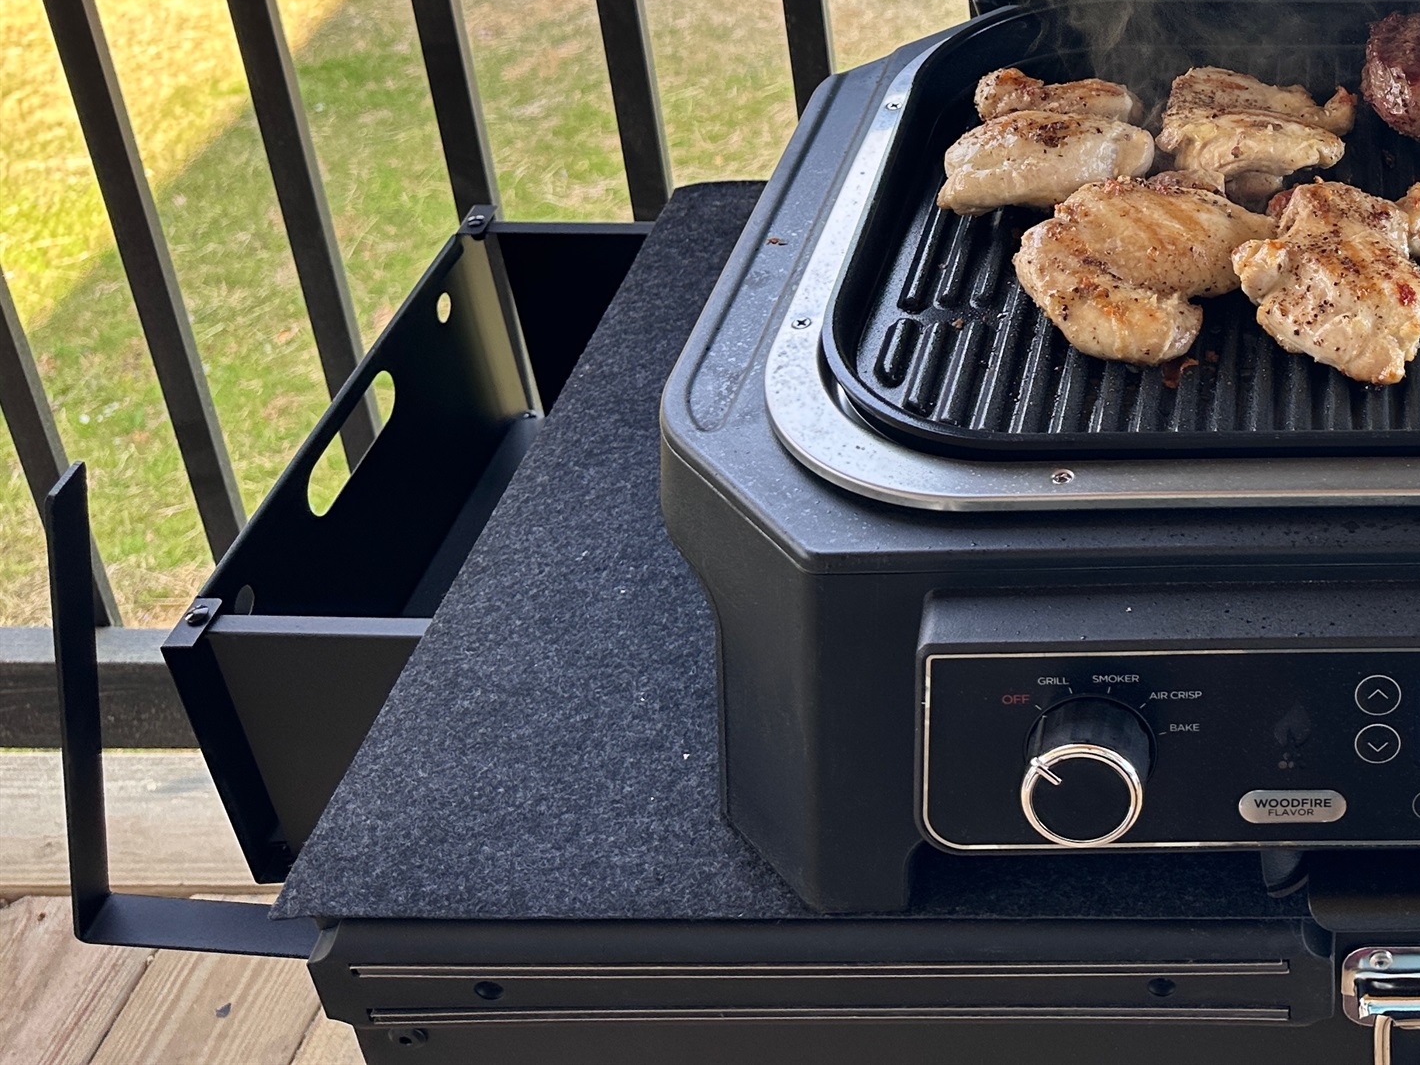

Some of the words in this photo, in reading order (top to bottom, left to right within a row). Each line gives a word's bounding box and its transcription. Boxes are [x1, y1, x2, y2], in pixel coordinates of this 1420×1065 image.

[1037, 676, 1069, 685] GRILL
[1092, 674, 1140, 683] SMOKER
[1002, 694, 1030, 705] OFF
[1149, 691, 1168, 700] AIR
[1170, 690, 1202, 699] CRISP
[1169, 723, 1200, 732] BAKE
[1254, 798, 1332, 808] WOODFIRE
[1268, 808, 1314, 816] FLAVOR
